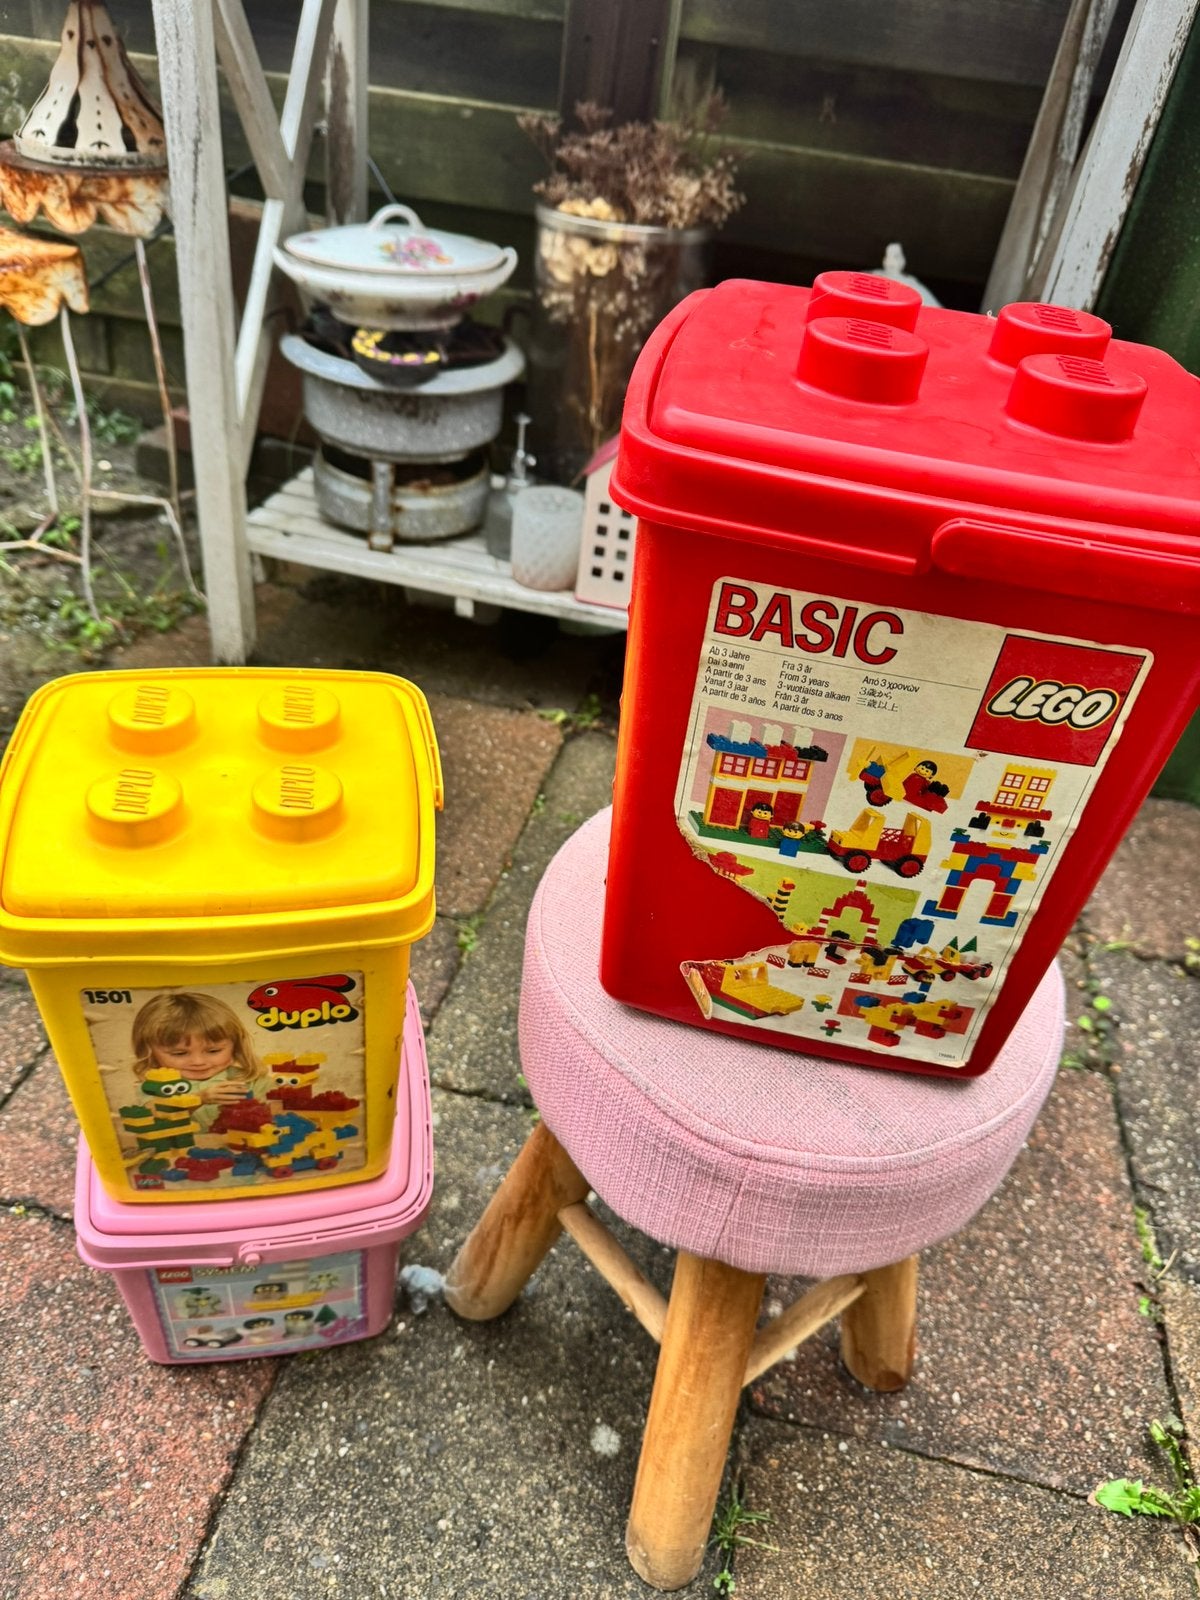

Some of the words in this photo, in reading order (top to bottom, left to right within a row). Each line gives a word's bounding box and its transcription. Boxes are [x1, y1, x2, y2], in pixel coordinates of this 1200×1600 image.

[714, 583, 904, 665] BASIC
[707, 657, 720, 665] Dai
[709, 646, 720, 656] Ab
[721, 648, 728, 657] 3
[729, 650, 750, 661] Jahre
[782, 660, 795, 670] Fra
[797, 663, 803, 672] 3
[804, 665, 813, 673] år
[704, 675, 726, 687] Vanaf
[727, 681, 733, 689] 3
[734, 683, 749, 692] jaar
[713, 668, 733, 678] partir
[734, 672, 744, 681] de
[752, 678, 767, 686] ans
[779, 671, 799, 682] From
[801, 675, 807, 683] 3
[808, 678, 830, 688] years
[880, 679, 887, 687] 3
[702, 685, 708, 693] A
[709, 688, 729, 698] partir
[730, 692, 740, 700] de
[741, 694, 747, 702] 3
[777, 681, 823, 697] 3-vuotiaista
[825, 691, 851, 702] alkaen
[793, 695, 800, 703] 3
[801, 696, 809, 704] år
[131, 685, 171, 725] DUPLO
[283, 685, 315, 724] DUPLO
[772, 700, 778, 708] A
[779, 703, 800, 713] partir
[801, 707, 815, 716] dos
[817, 709, 823, 717] 3
[824, 712, 844, 721] anos
[987, 676, 1120, 729] LEGO
[112, 768, 155, 815] DUPLO
[279, 766, 316, 810] DUPLO
[84, 990, 132, 1004] 1501
[256, 1001, 353, 1028] duplo
